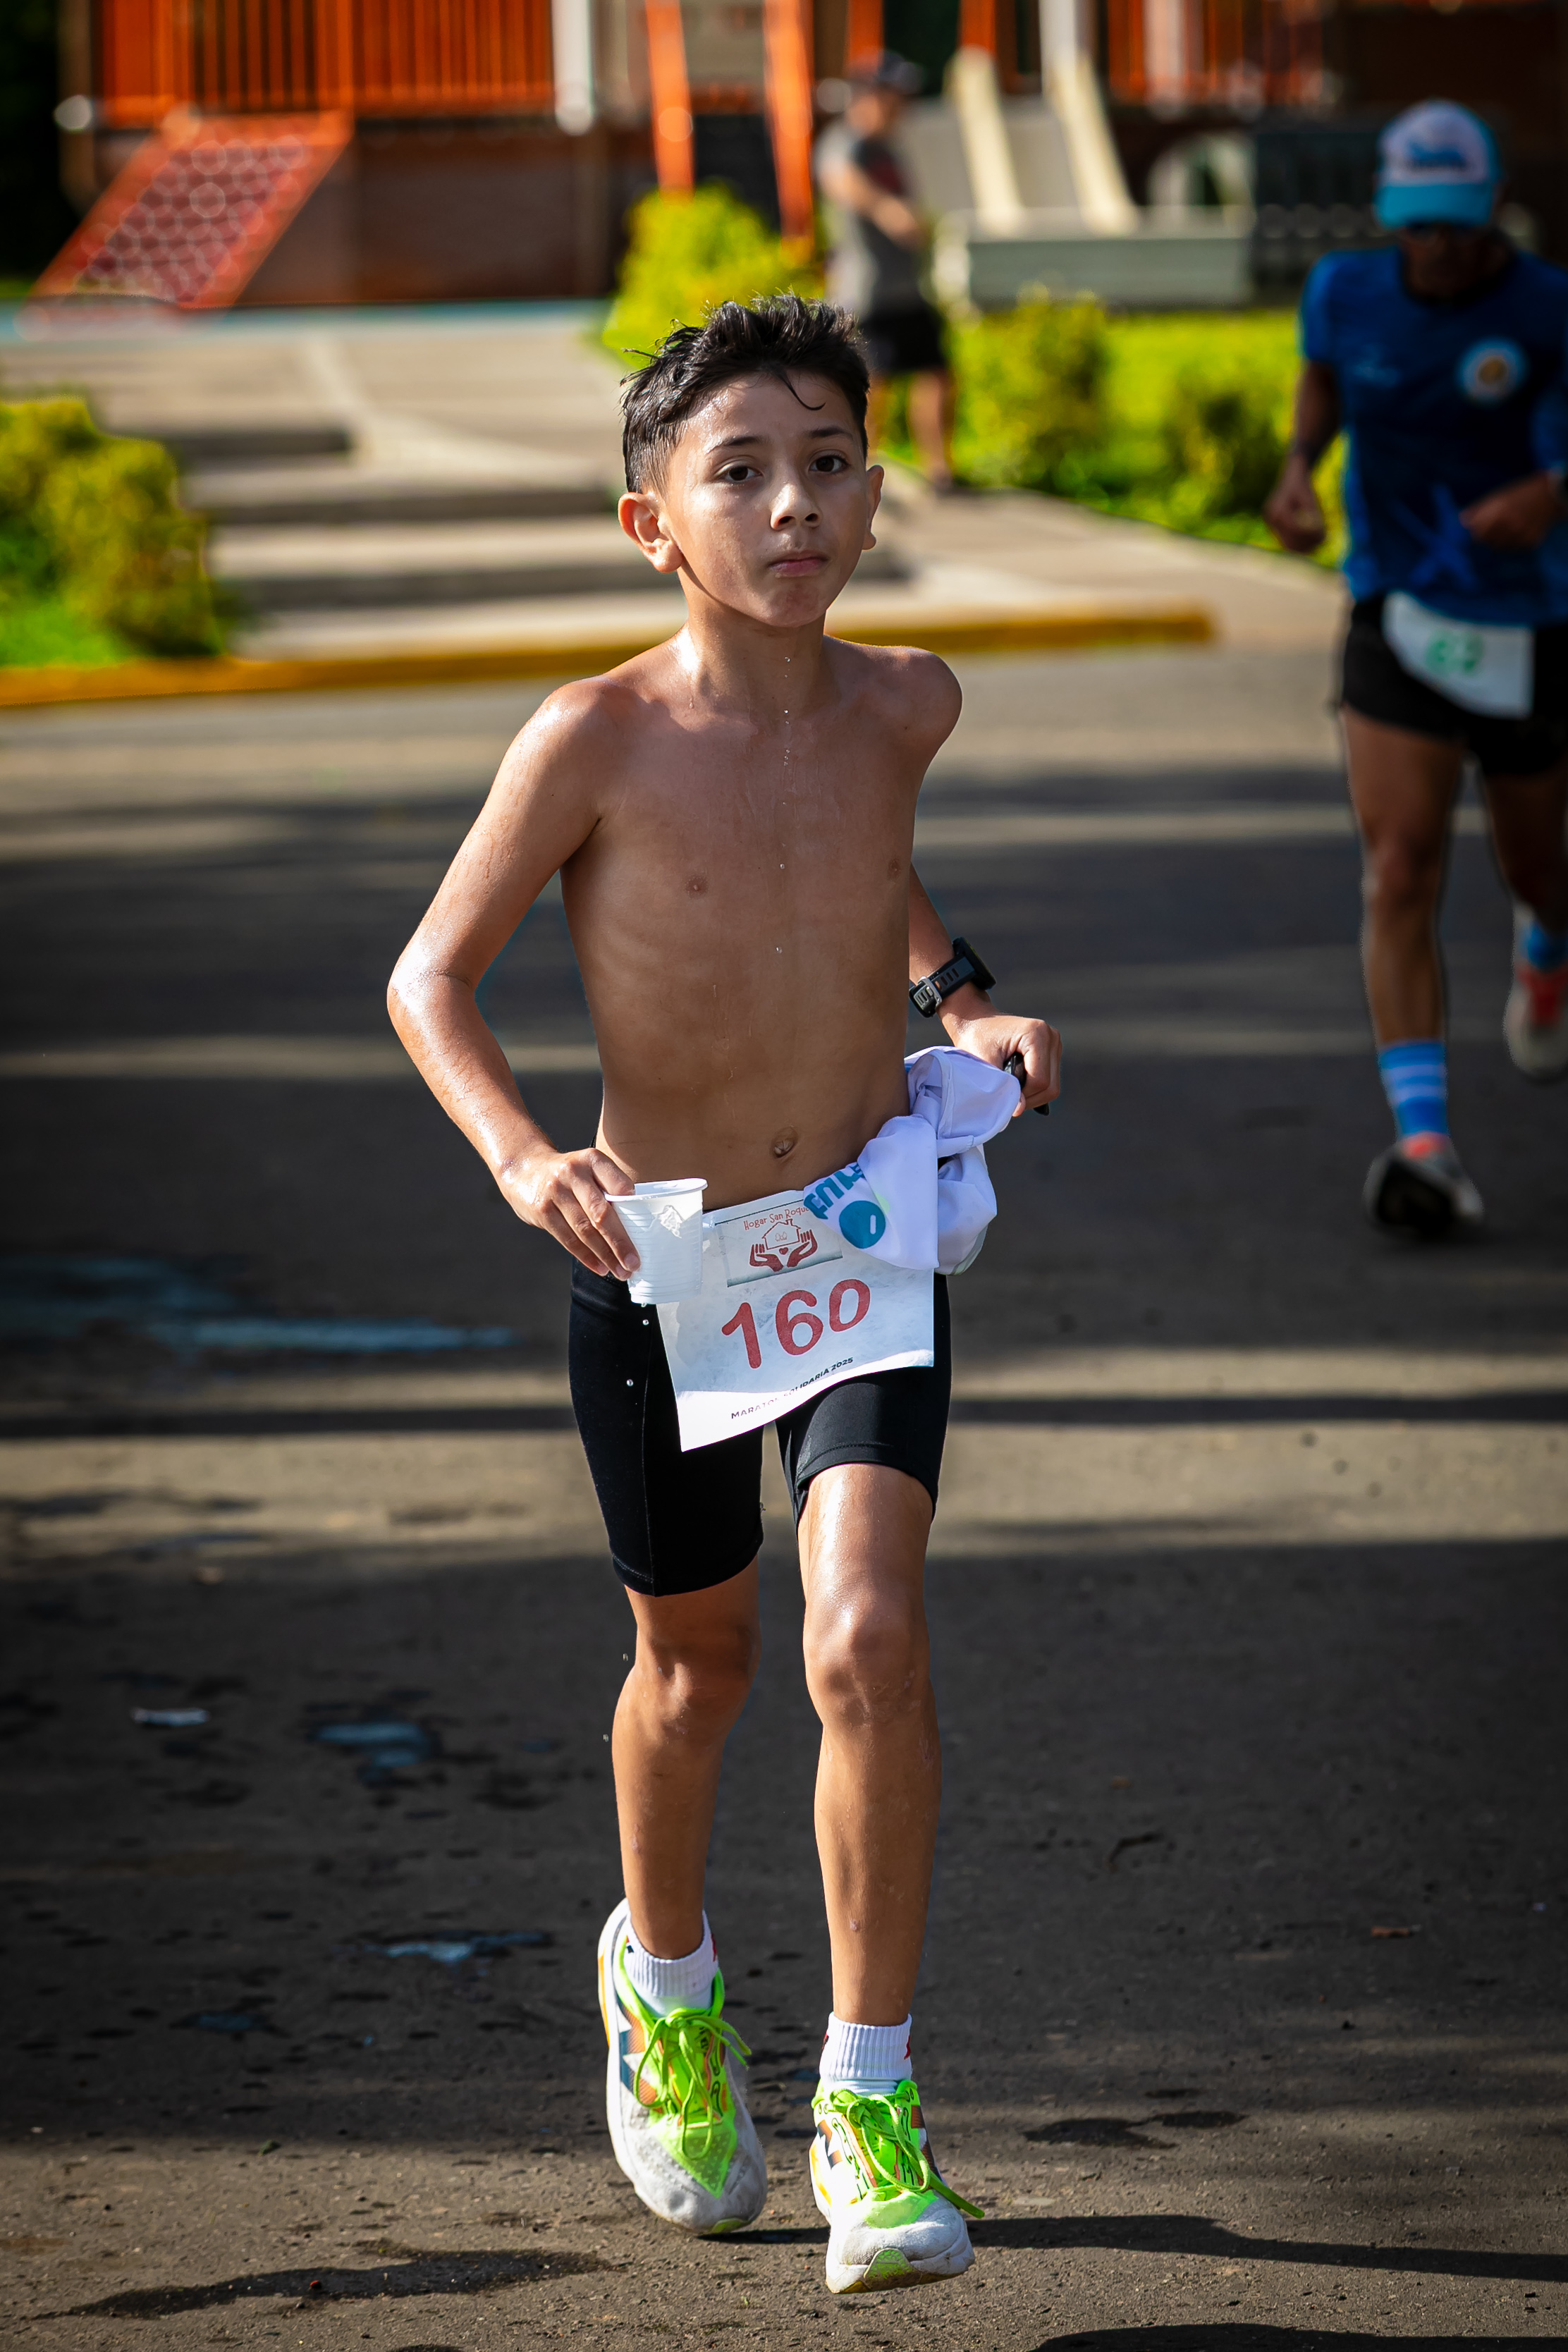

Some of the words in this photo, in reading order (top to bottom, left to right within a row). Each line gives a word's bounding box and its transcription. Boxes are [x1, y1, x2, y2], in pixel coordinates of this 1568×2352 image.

[743, 1217, 767, 1230] Hogar
[769, 1212, 783, 1223] San
[721, 1278, 871, 1369] 160
[831, 1356, 854, 1371] 2025
